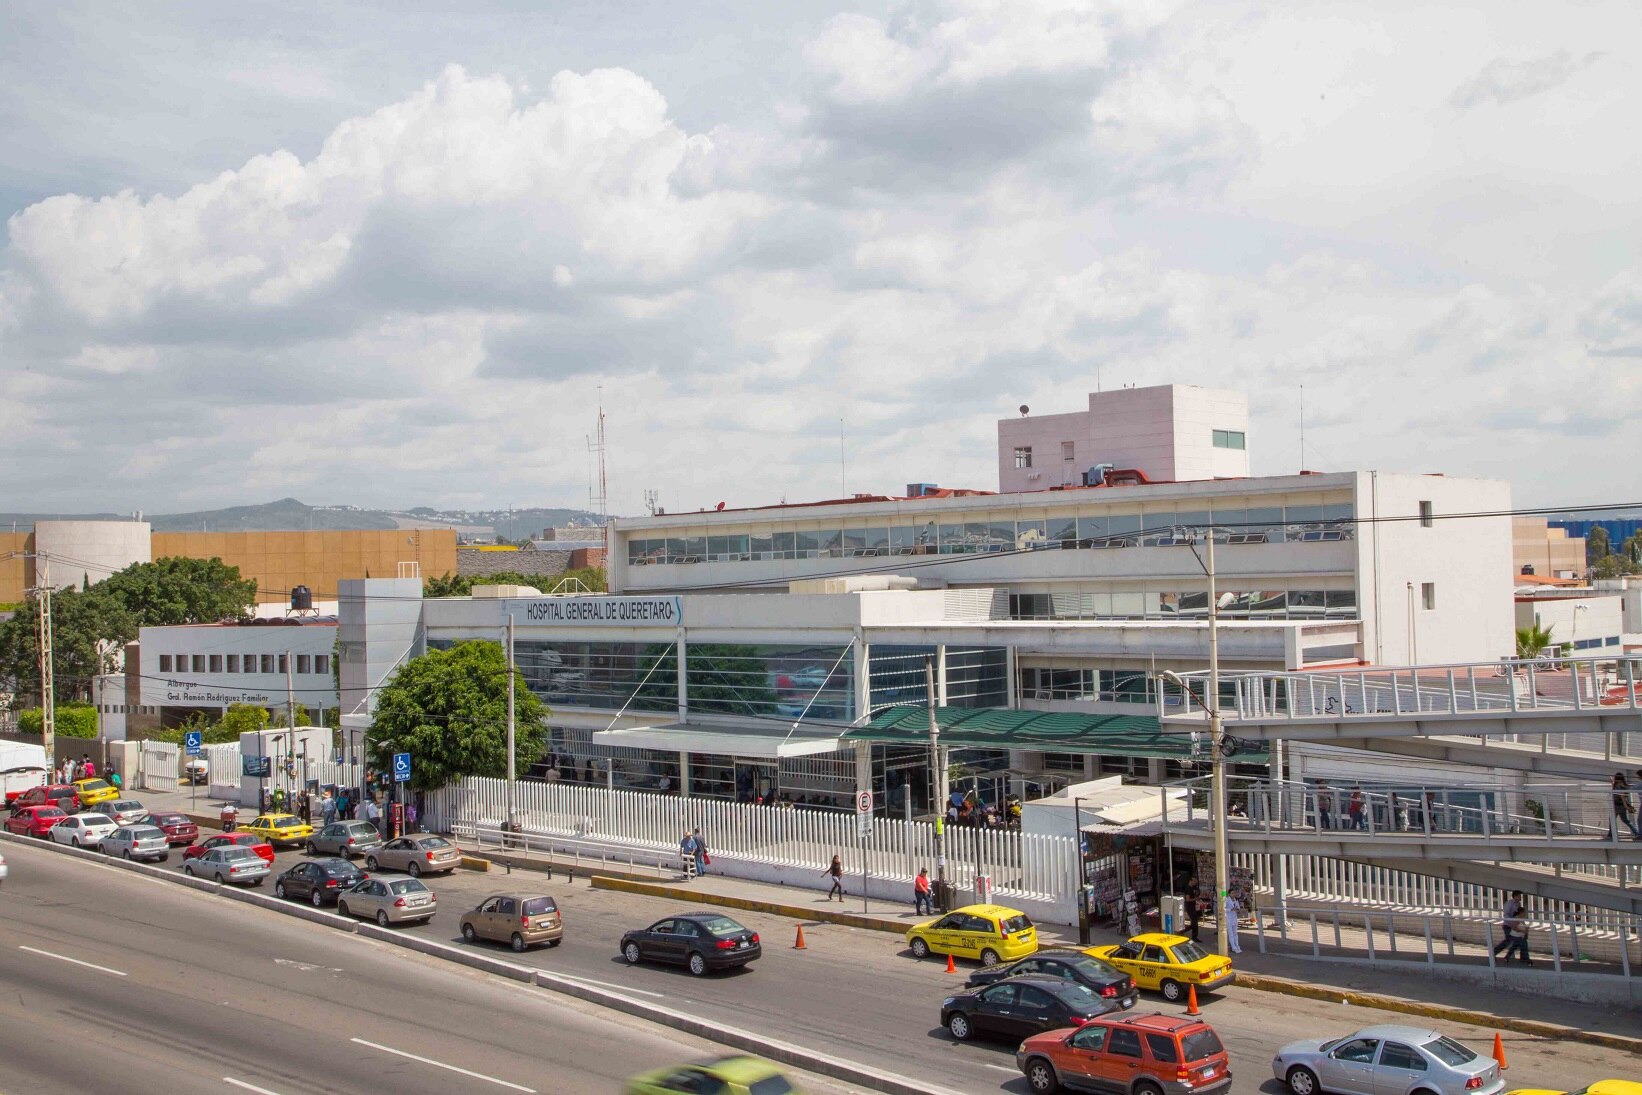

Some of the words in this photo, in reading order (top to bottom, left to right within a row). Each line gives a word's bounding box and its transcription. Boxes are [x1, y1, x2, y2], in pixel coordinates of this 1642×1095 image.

[527, 603, 564, 620] HOSPITAL
[566, 602, 603, 620] GENERAL
[605, 602, 617, 620] DE
[618, 601, 672, 620] QUERETARO
[168, 680, 197, 690] Albergue
[184, 692, 205, 701] Ramón
[242, 693, 269, 702] Familiar
